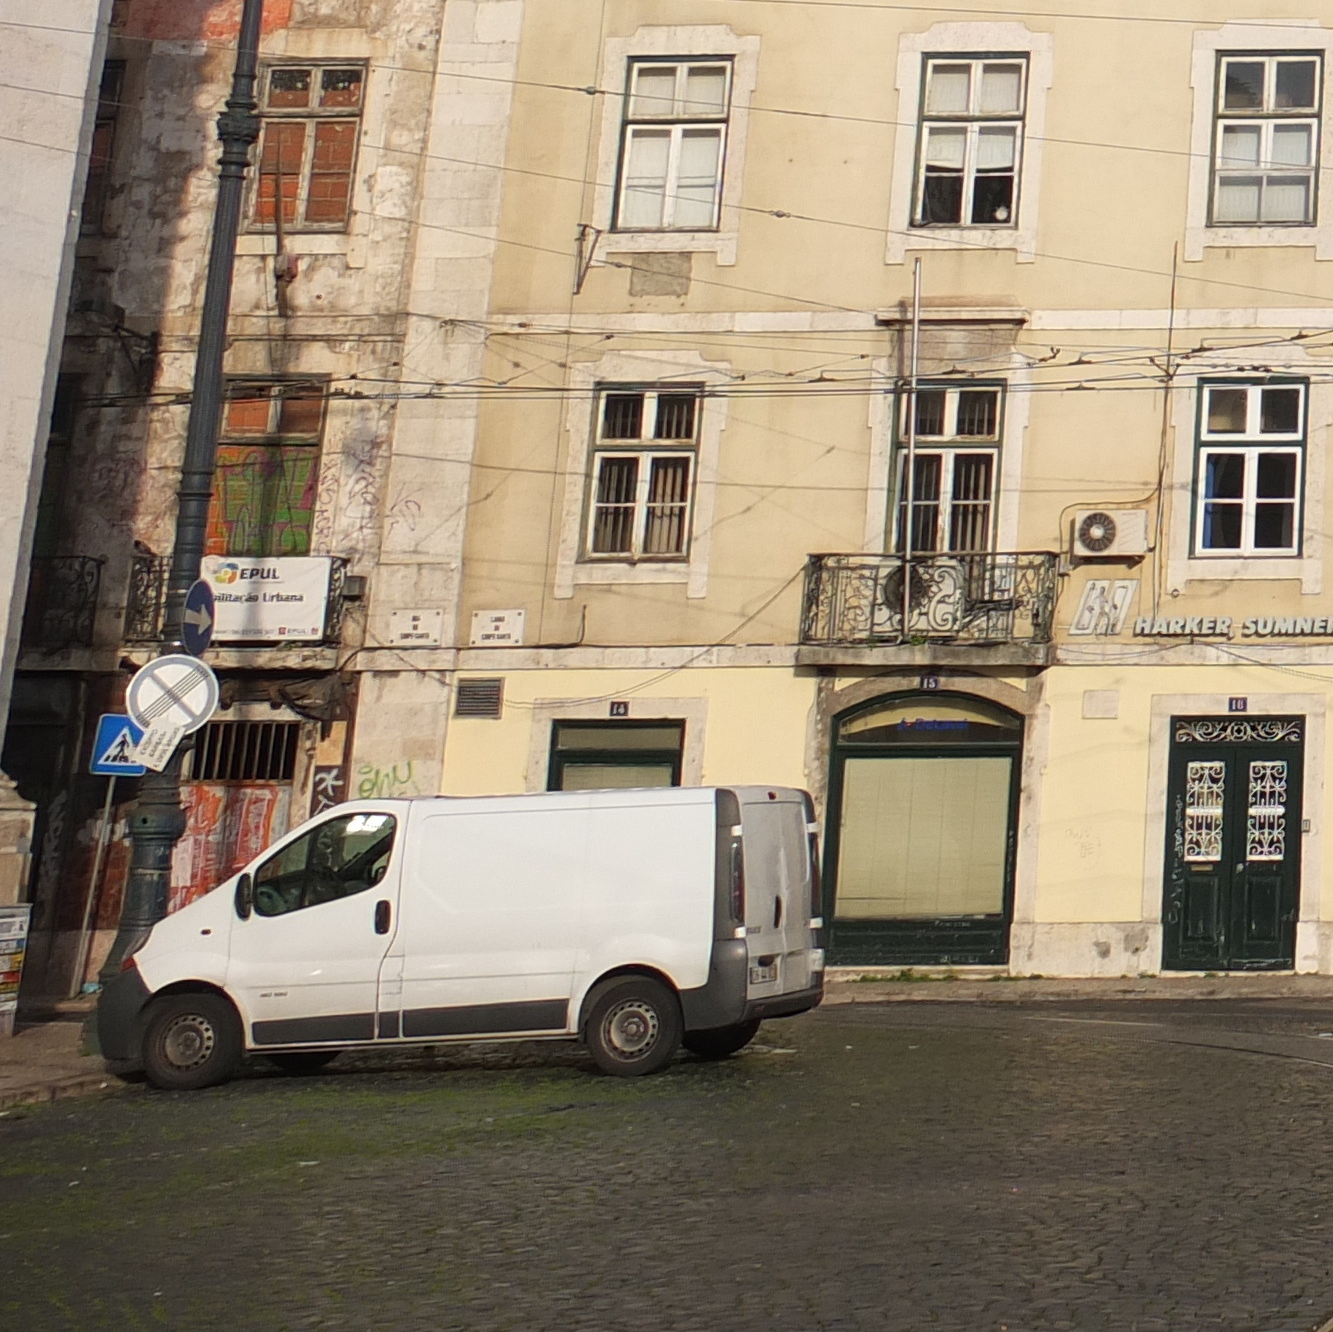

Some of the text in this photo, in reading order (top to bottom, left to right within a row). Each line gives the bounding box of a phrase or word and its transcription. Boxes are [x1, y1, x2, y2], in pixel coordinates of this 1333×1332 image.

[240, 568, 280, 580] EPUL
[214, 590, 304, 605] ilitação Urbana
[1132, 616, 1235, 641] HARKER,
[923, 678, 936, 688] 15
